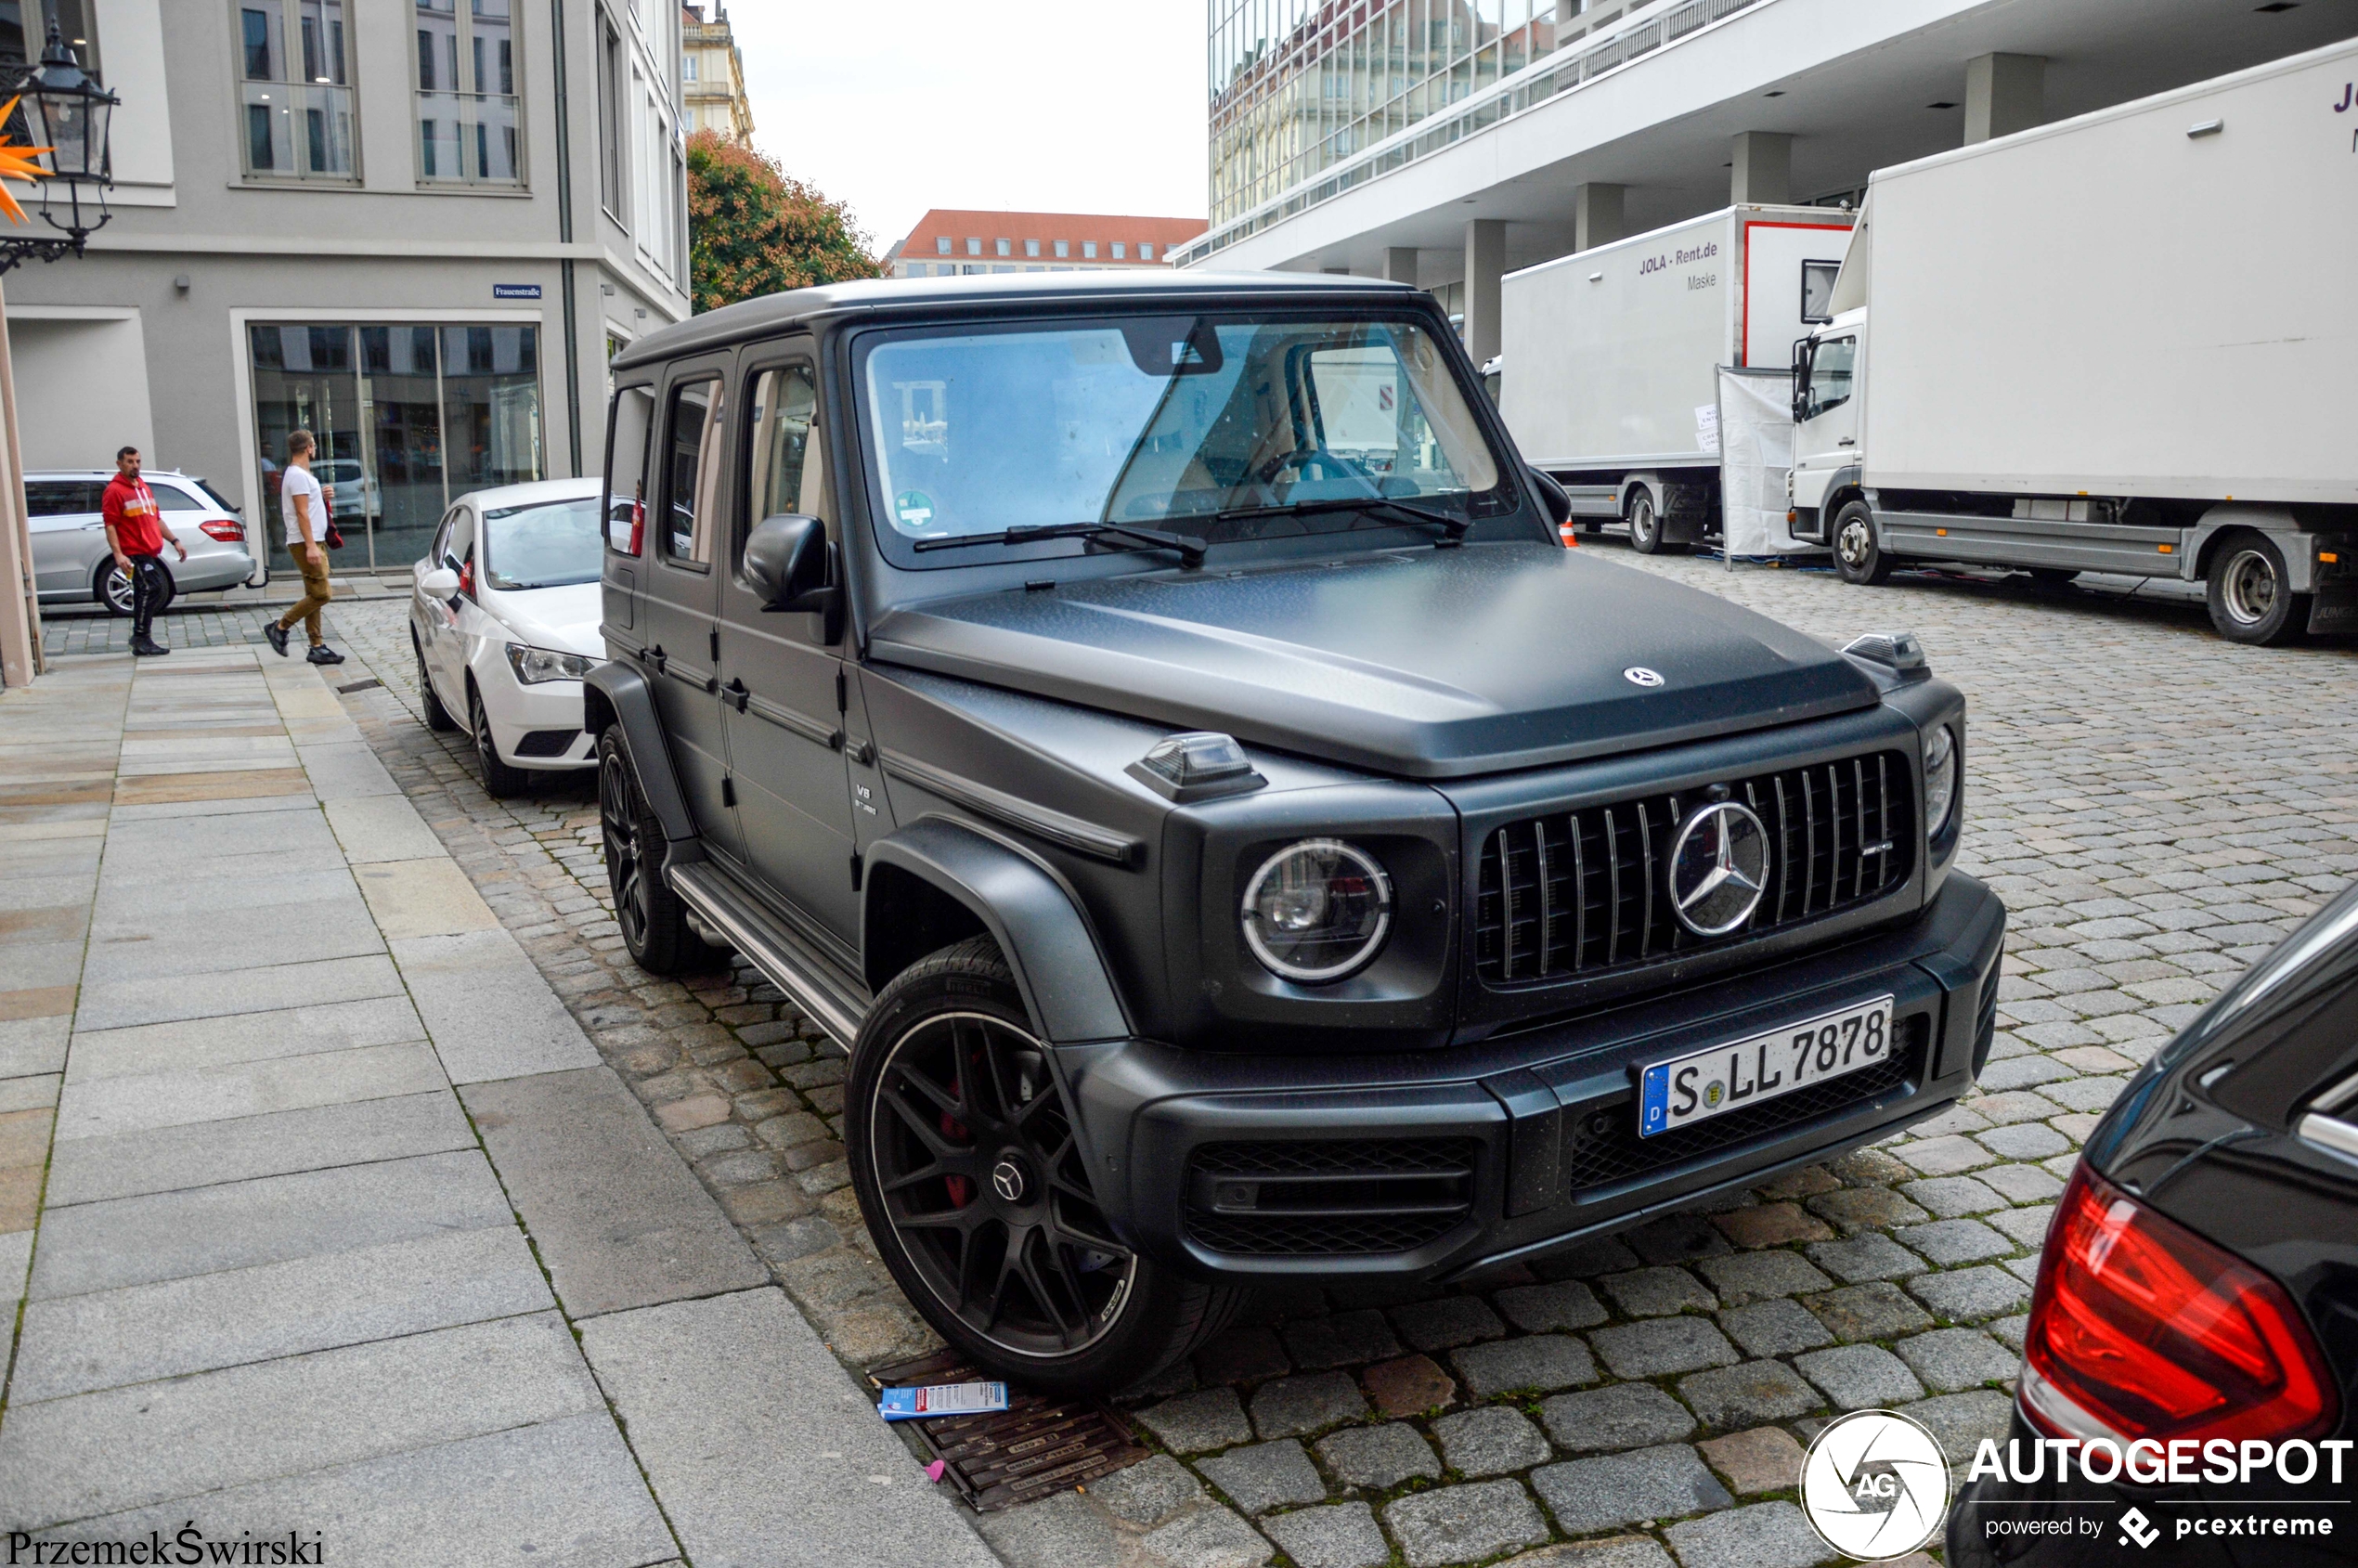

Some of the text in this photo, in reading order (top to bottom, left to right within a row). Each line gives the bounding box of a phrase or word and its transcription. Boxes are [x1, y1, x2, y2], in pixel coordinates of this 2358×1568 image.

[2334, 82, 2358, 112] J
[1639, 254, 1666, 275] JOLA
[1676, 241, 1717, 266] Rent.de
[495, 287, 540, 296] Frauenstraße
[1687, 272, 1717, 292] Maske
[856, 784, 871, 798] V8
[1672, 1009, 1885, 1117] S LL 7878
[1650, 1106, 1660, 1121] D
